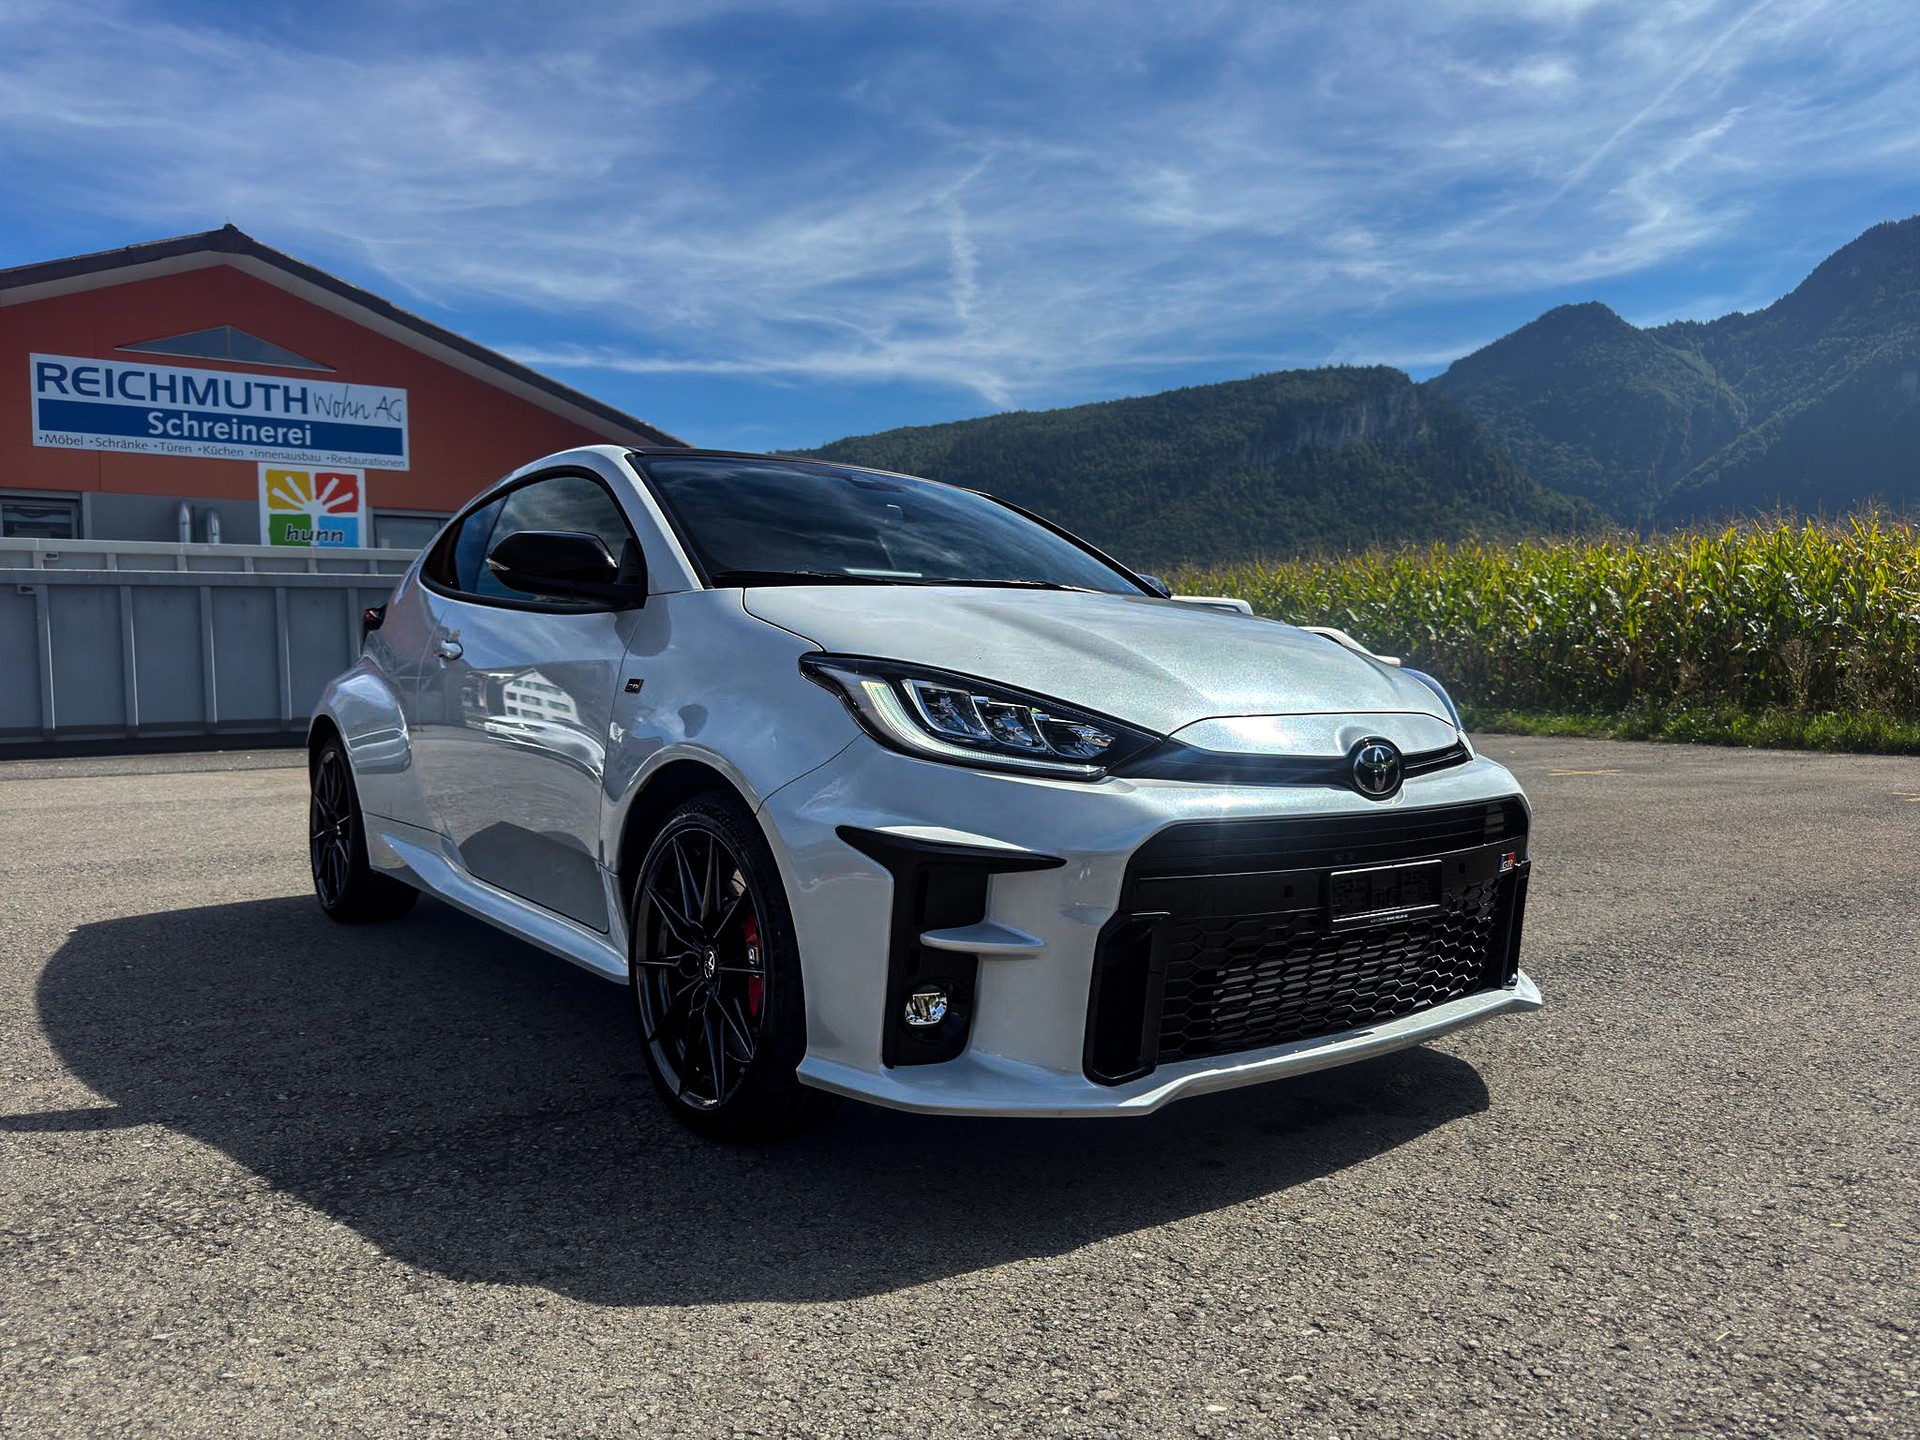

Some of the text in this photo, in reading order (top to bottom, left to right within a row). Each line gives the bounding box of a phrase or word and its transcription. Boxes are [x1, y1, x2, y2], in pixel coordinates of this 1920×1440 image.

[36, 361, 403, 423] REICHMUTH Wohn AG
[147, 411, 312, 446] Schreinerei
[286, 524, 344, 543] hunn
